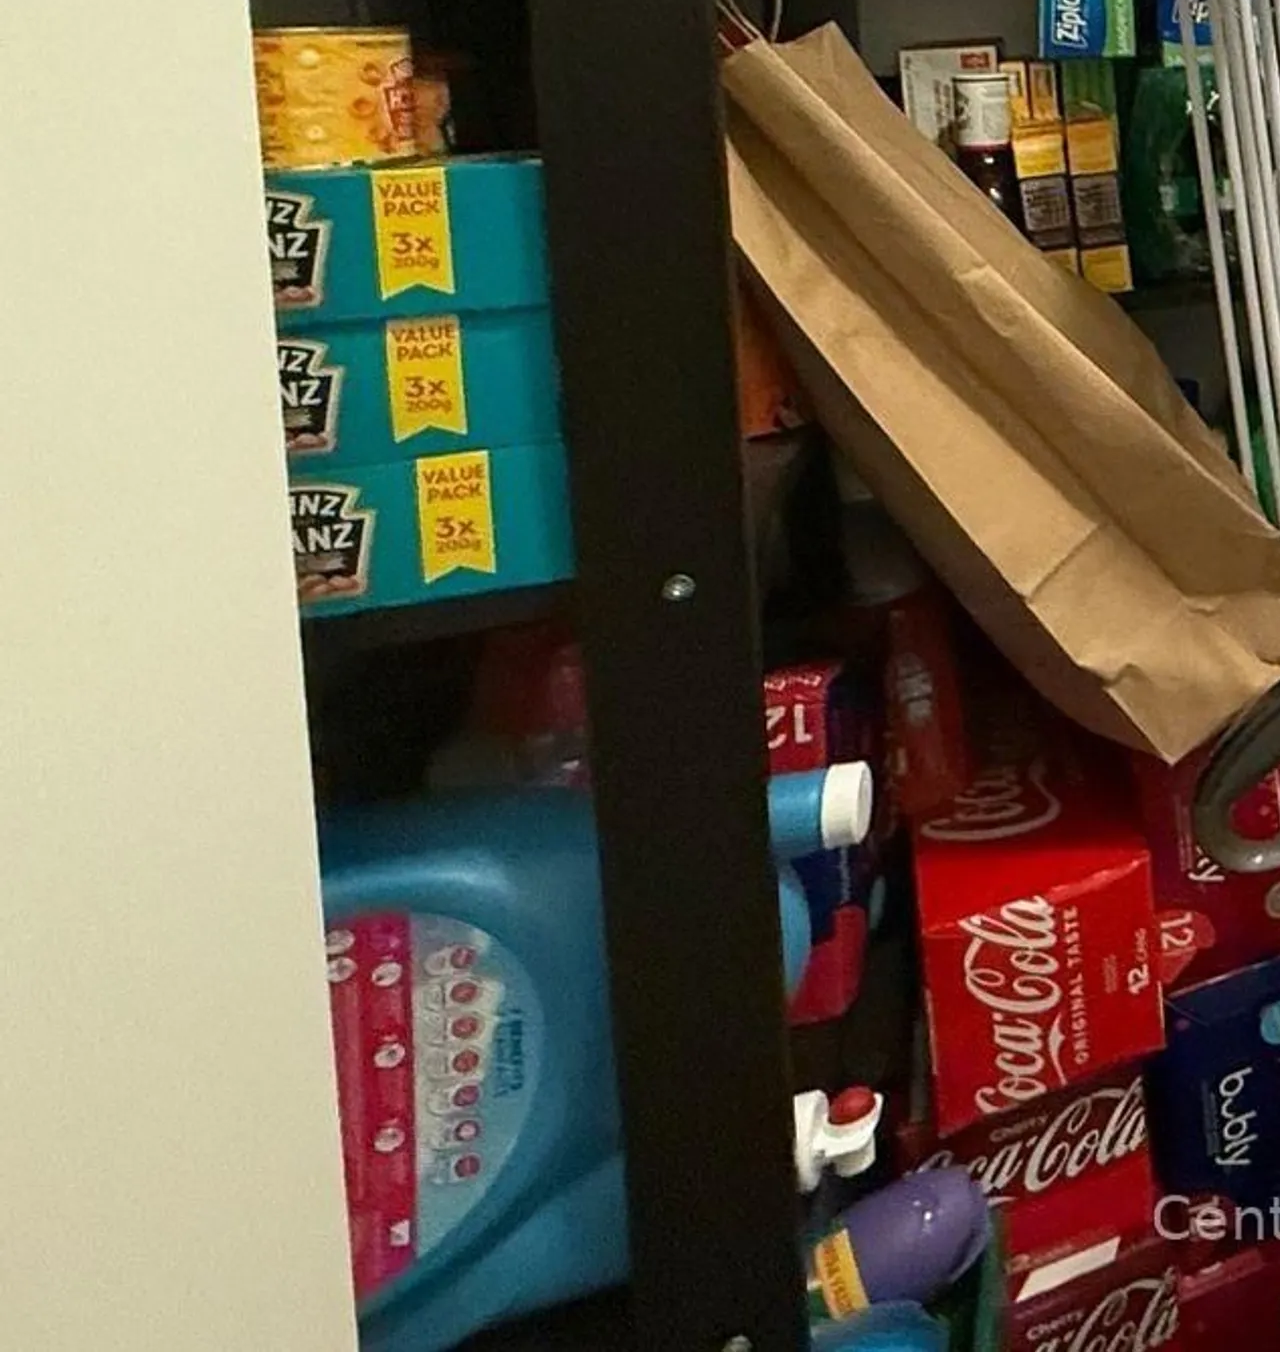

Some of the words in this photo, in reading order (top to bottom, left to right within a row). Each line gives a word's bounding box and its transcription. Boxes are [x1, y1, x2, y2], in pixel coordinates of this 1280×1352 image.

[379, 181, 443, 199] VALUE
[383, 199, 440, 217] PACK
[392, 232, 434, 255] 3x
[389, 323, 456, 343] VALUE
[397, 342, 453, 362] PACK
[405, 375, 448, 398] 3x
[421, 463, 485, 484] VALUE
[427, 483, 482, 504] PACK
[436, 516, 476, 539] 3x
[1063, 905, 1082, 969] TASTE
[1159, 910, 1196, 950] 12
[1127, 962, 1150, 996] 12
[1067, 975, 1090, 1065] ORIGINAL
[1213, 1066, 1259, 1167] bubly
